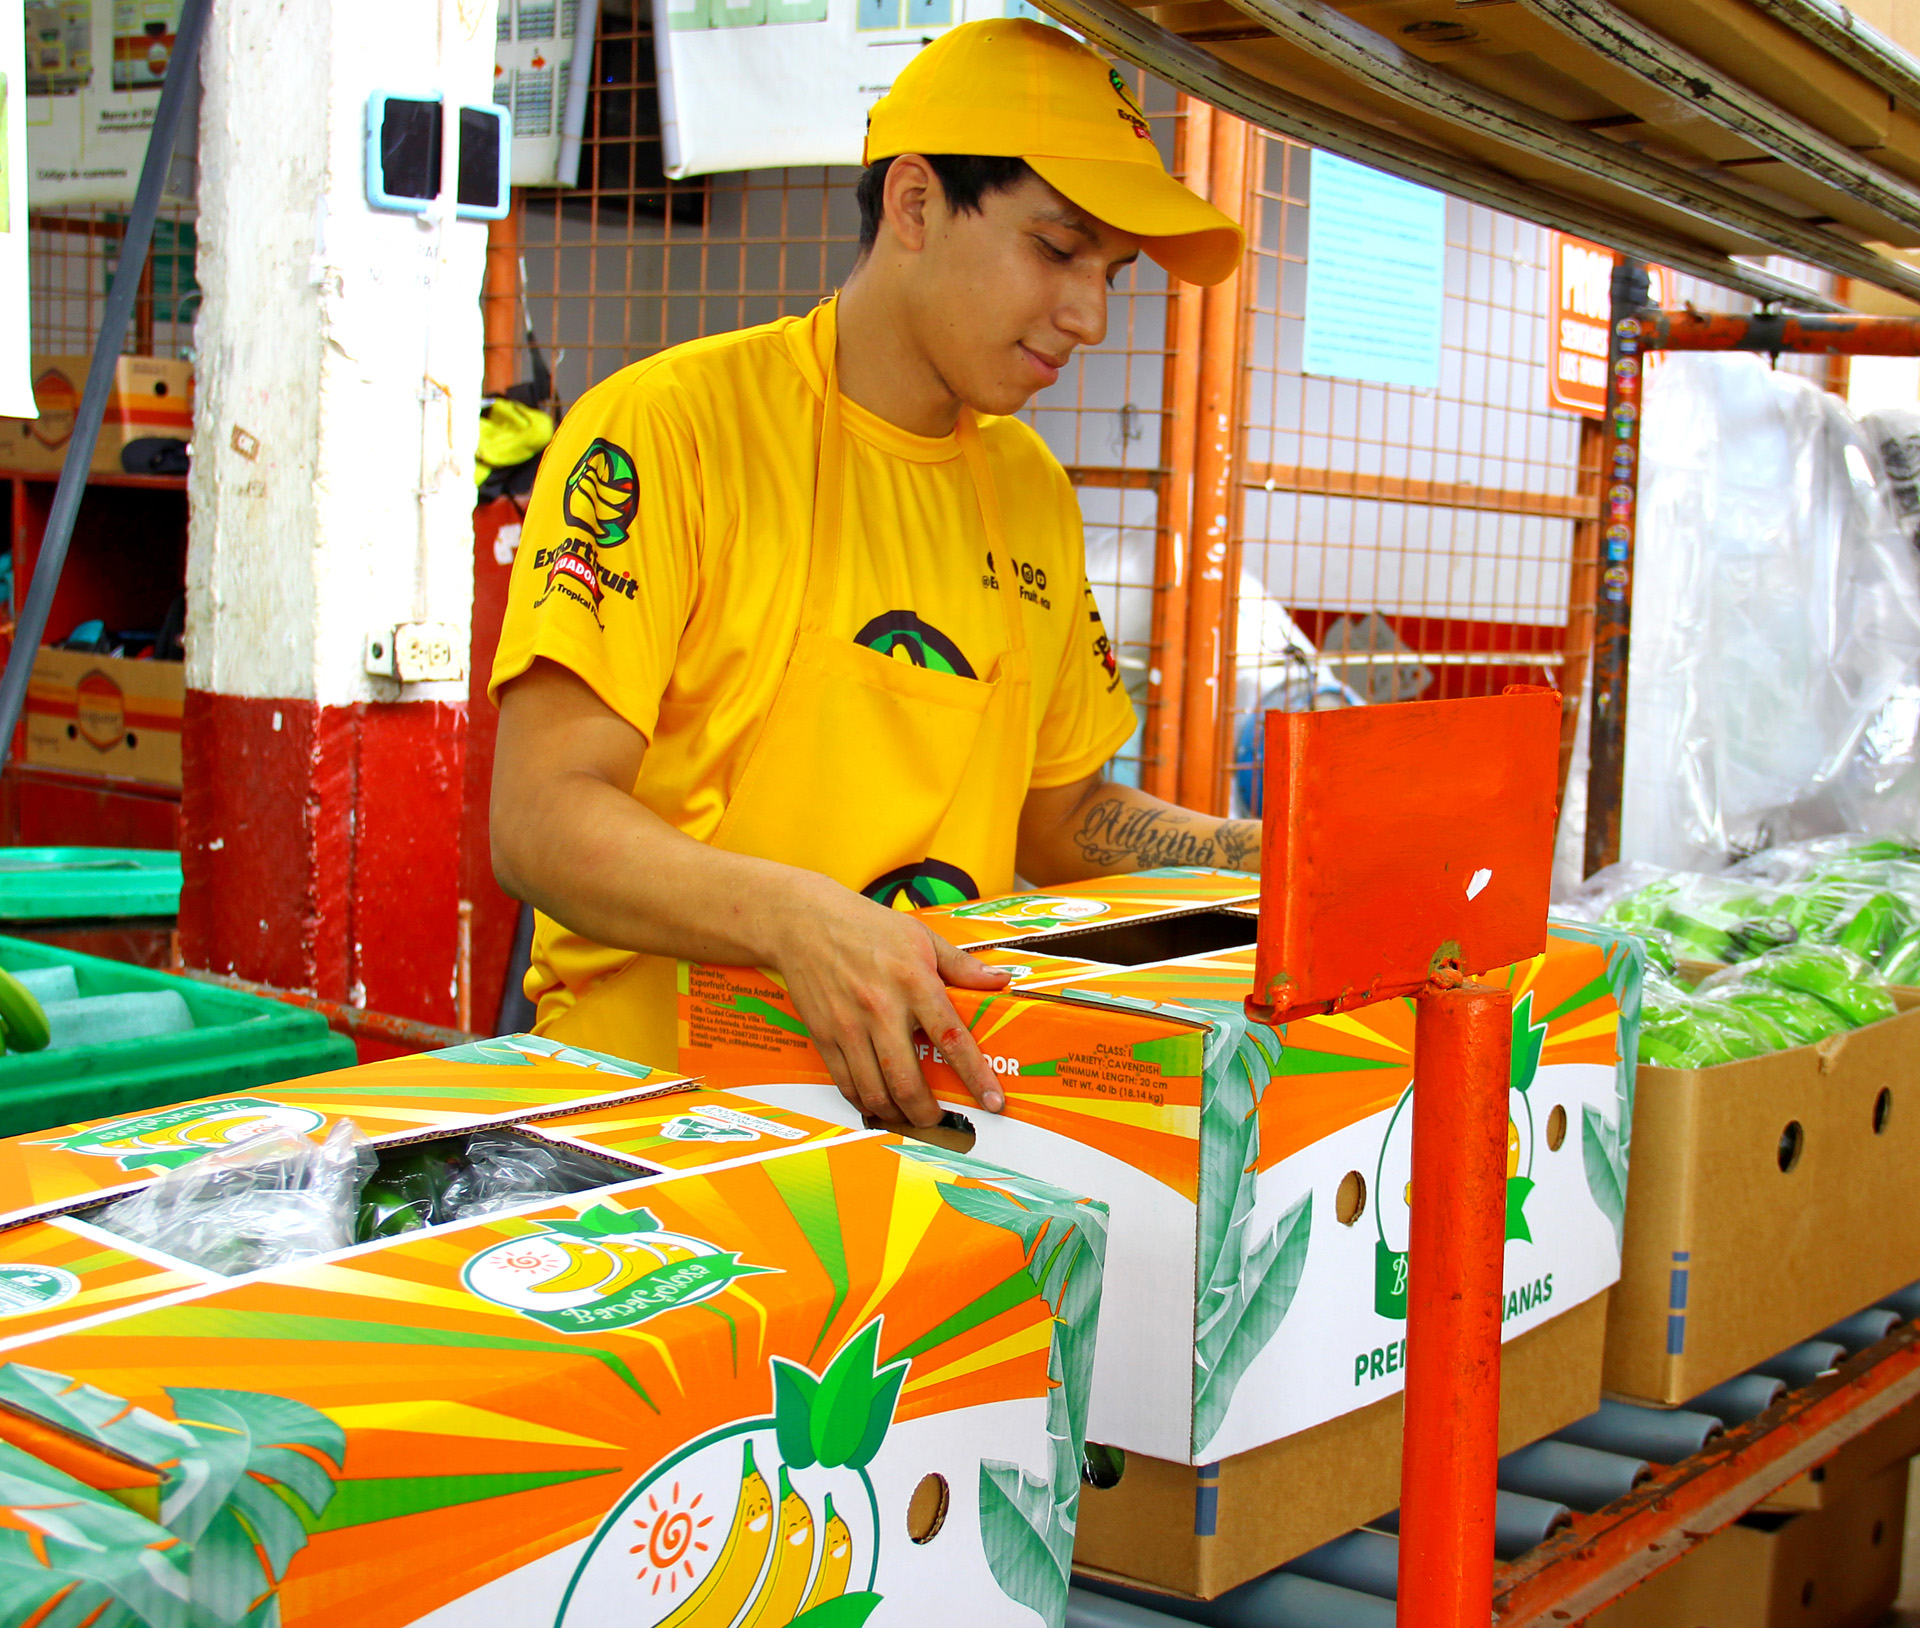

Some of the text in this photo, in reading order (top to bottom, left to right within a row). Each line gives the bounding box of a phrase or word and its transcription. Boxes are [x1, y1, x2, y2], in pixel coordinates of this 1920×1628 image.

[726, 983, 752, 995] Cadena
[754, 987, 785, 1000] Andrade
[1096, 1044, 1126, 1057] CLASS:
[1068, 1052, 1160, 1075] VARIETY: CAVENDISH
[1058, 1064, 1168, 1089] MINIMUM LENGTH: 20 cm
[1062, 1078, 1164, 1104] NET WT. 40 lb (18.14 kg)
[561, 1264, 711, 1324] BanaGolosa
